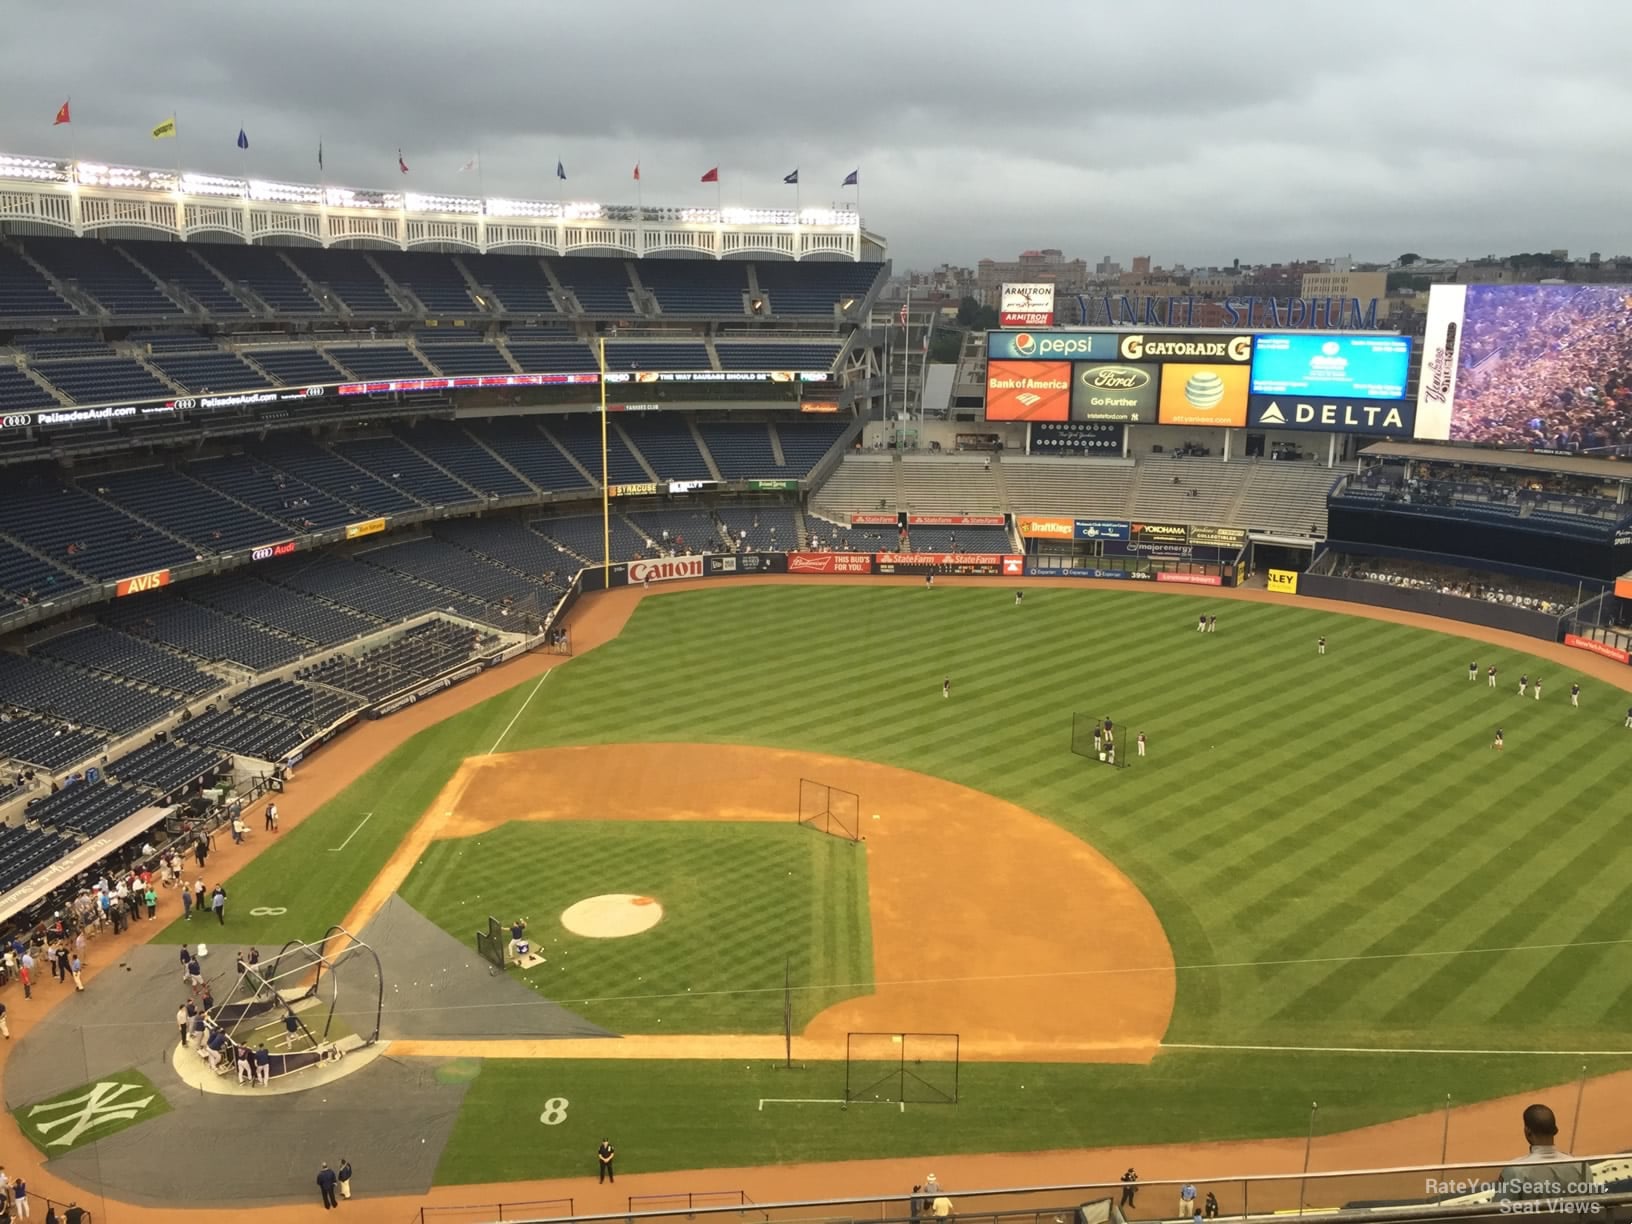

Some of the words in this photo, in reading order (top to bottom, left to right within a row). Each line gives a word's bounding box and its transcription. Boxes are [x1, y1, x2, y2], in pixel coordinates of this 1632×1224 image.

[1004, 287, 1052, 295] ARMITRON
[1005, 313, 1048, 321] ARMITRON
[1076, 294, 1199, 326] YANKEE
[1222, 296, 1380, 330] STADIUM
[1040, 336, 1092, 355] pepsi
[1145, 342, 1227, 356] GATORADE
[990, 378, 1015, 388] Bank
[1015, 378, 1027, 388] of
[1027, 379, 1068, 389] America
[1094, 369, 1137, 387] Ford
[201, 393, 277, 408] PalisadesAudi.com
[1090, 397, 1104, 405] Go
[1105, 398, 1138, 406] Further
[38, 406, 136, 424] PalisadesAudi.com
[1295, 403, 1403, 427] DELTA
[617, 483, 657, 493] SYRACUSE
[1031, 521, 1072, 534] DraftKings
[1143, 525, 1186, 535] YOKOHAMA
[274, 543, 295, 555] Audi
[629, 559, 703, 581] Canon
[128, 573, 160, 594] AVIS
[540, 1096, 569, 1126] 8
